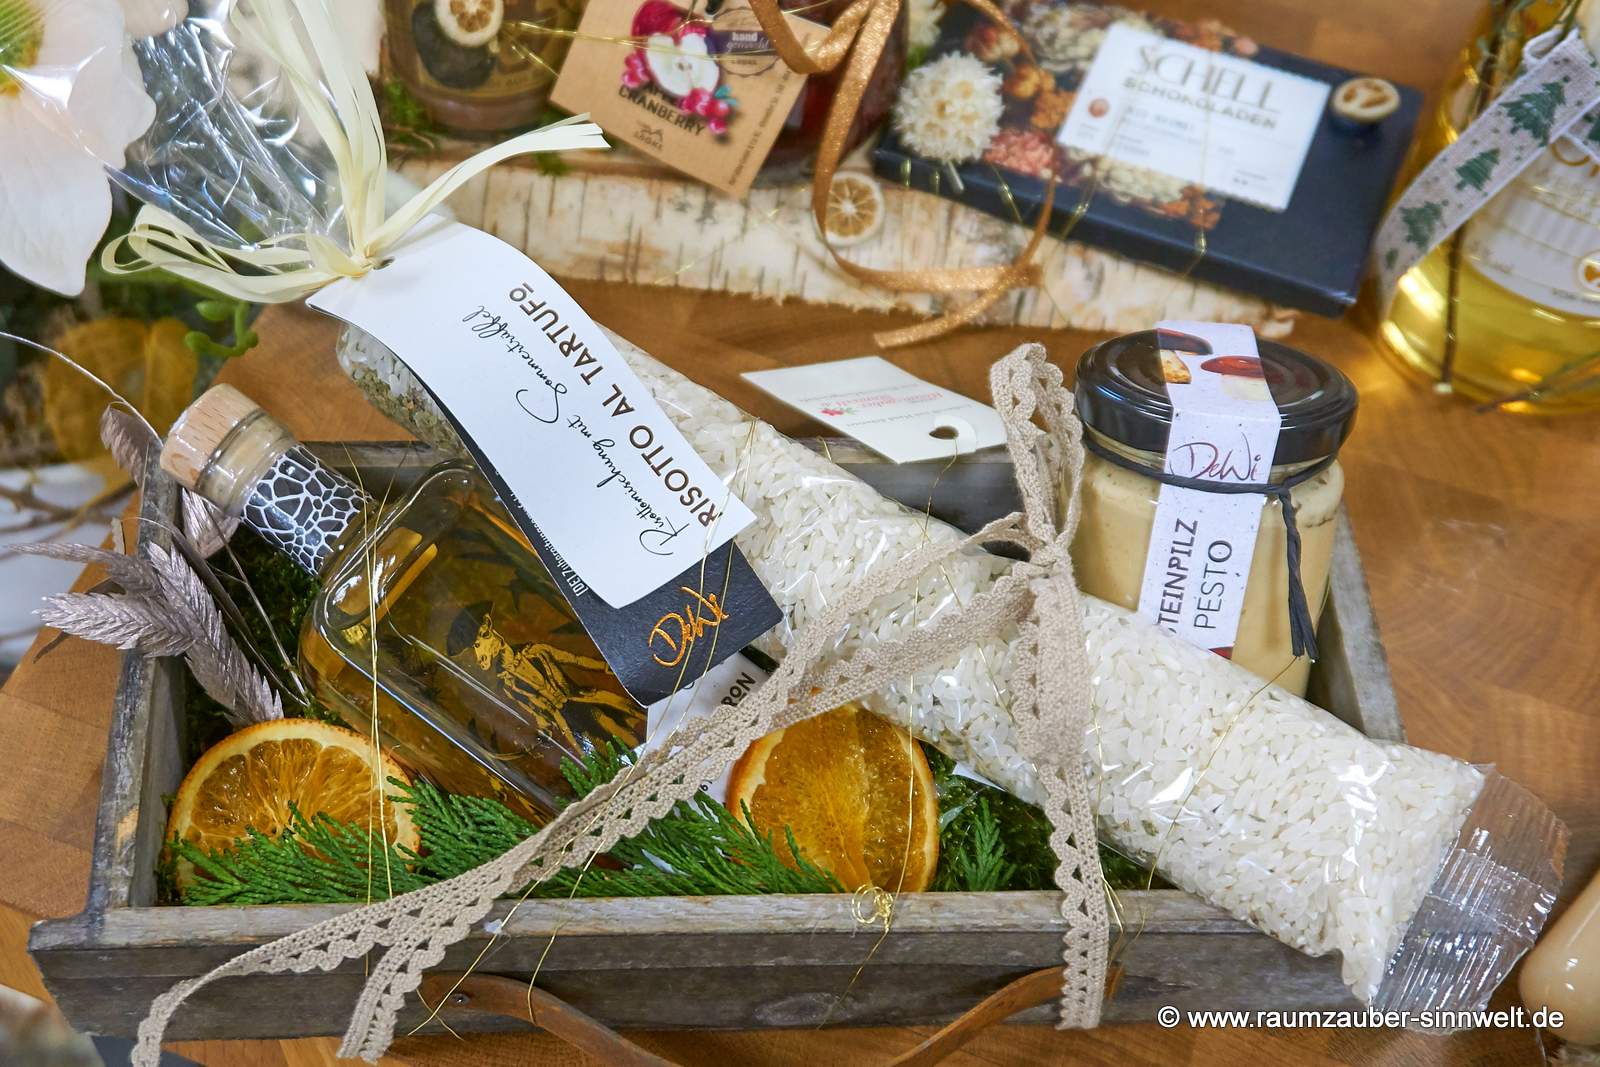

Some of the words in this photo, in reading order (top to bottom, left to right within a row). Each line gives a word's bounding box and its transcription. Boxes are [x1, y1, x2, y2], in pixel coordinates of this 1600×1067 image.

[618, 84, 706, 137] CRANBERRY
[1123, 76, 1279, 129] SCHOKOLADEN
[1130, 45, 1280, 114] SCHELL
[567, 414, 593, 438] mit
[602, 383, 635, 417] AL
[592, 438, 690, 556] Risottomischung
[629, 424, 723, 527] RISOTTO
[1157, 518, 1199, 634] TEINPILZ
[1193, 540, 1233, 629] PESTO
